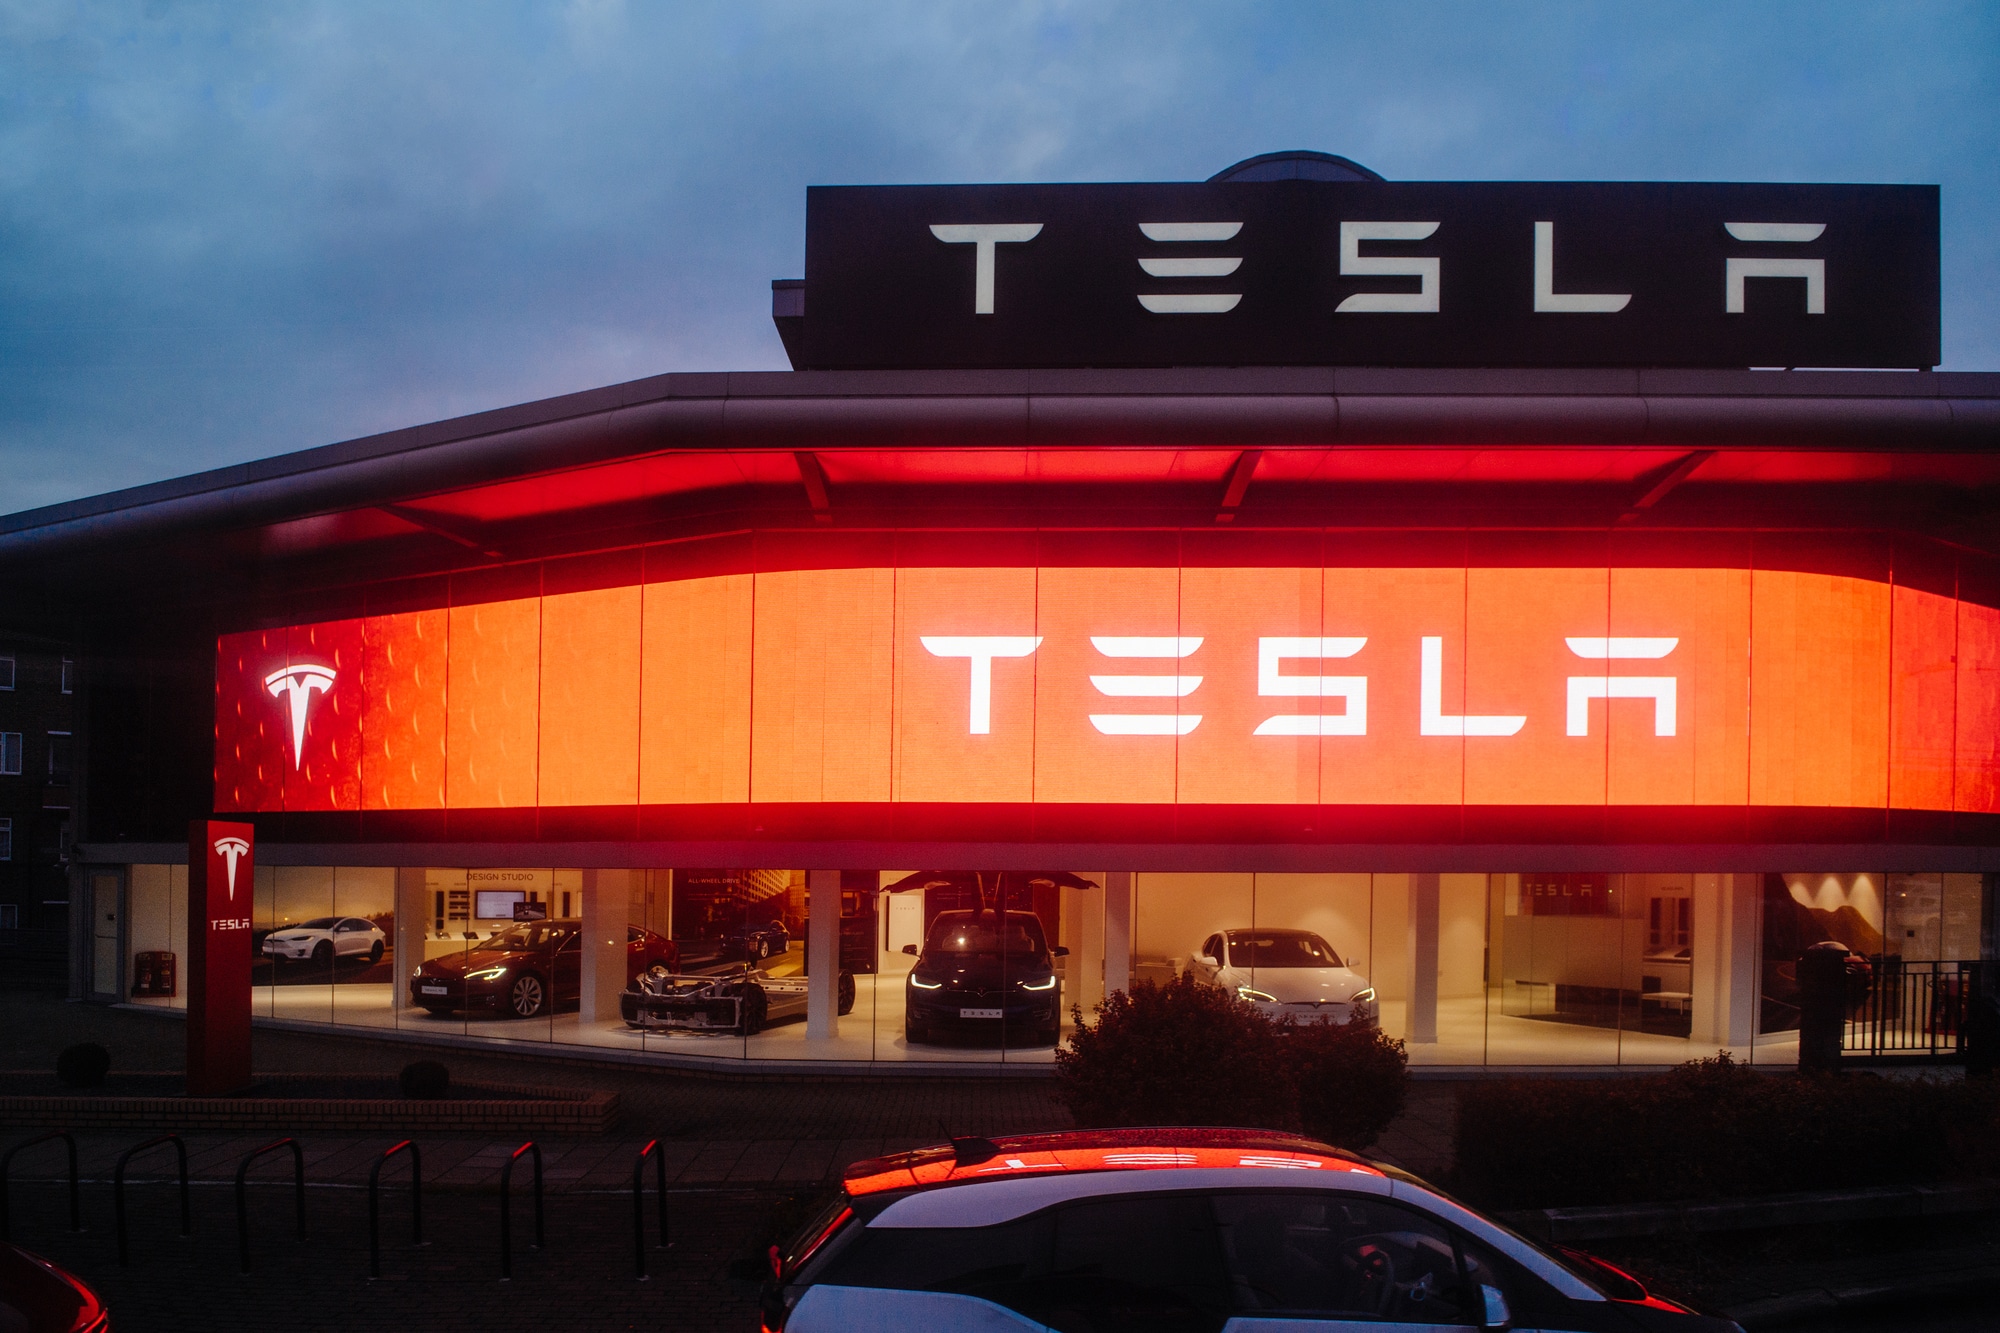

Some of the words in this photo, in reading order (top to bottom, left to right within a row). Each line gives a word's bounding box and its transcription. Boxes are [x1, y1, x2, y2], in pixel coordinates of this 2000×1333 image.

[930, 221, 1826, 314] TESLA
[920, 635, 1679, 738] TESLA
[466, 873, 499, 881] DESIGN
[501, 873, 534, 881] STUDIO
[1526, 883, 1593, 897] TESLA
[211, 918, 250, 931] TESLA
